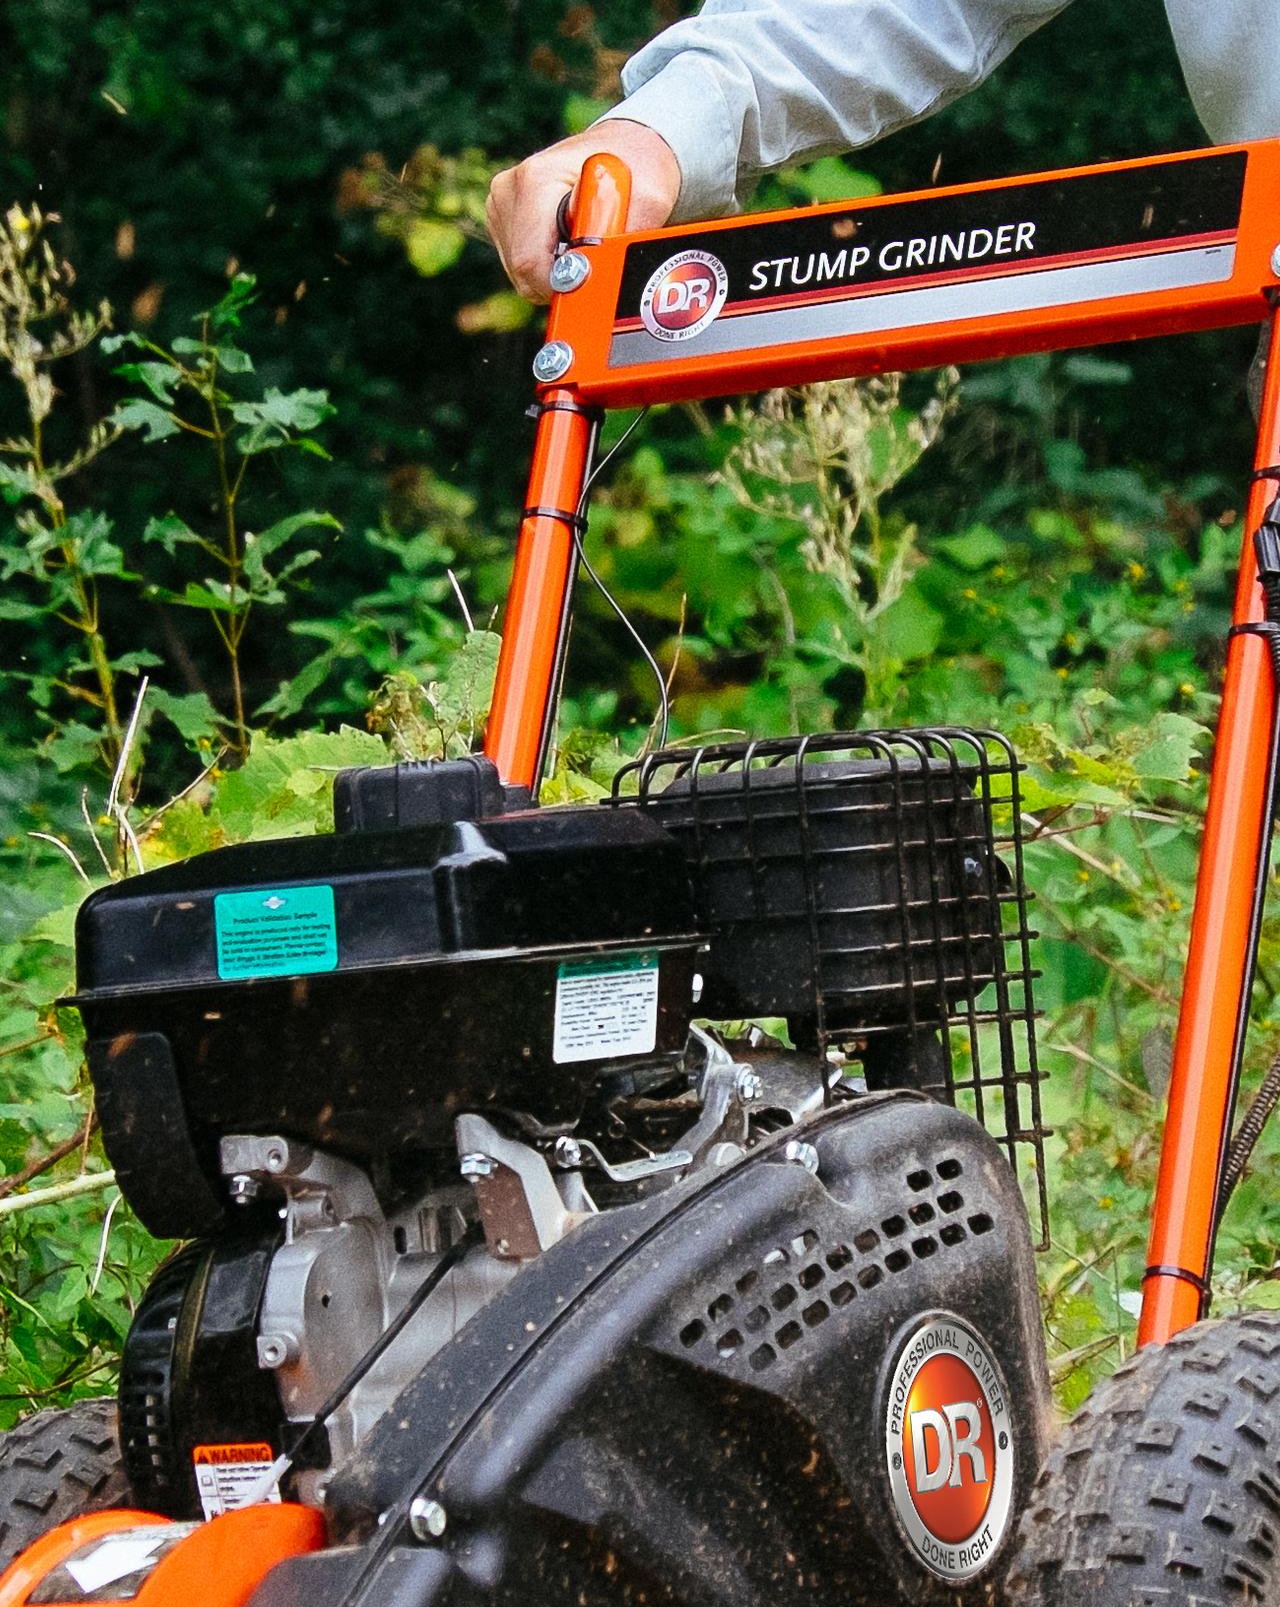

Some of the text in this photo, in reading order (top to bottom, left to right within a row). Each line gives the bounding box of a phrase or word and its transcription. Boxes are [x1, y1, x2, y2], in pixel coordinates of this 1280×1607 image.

[749, 221, 1036, 291] STUMP GRINDER
[657, 278, 711, 313] DR
[890, 1328, 1005, 1436] PROFESSIONAL POWER
[210, 1447, 269, 1463] WARNING
[909, 1400, 988, 1494] DR
[921, 1524, 994, 1570] DONE RIGHT
